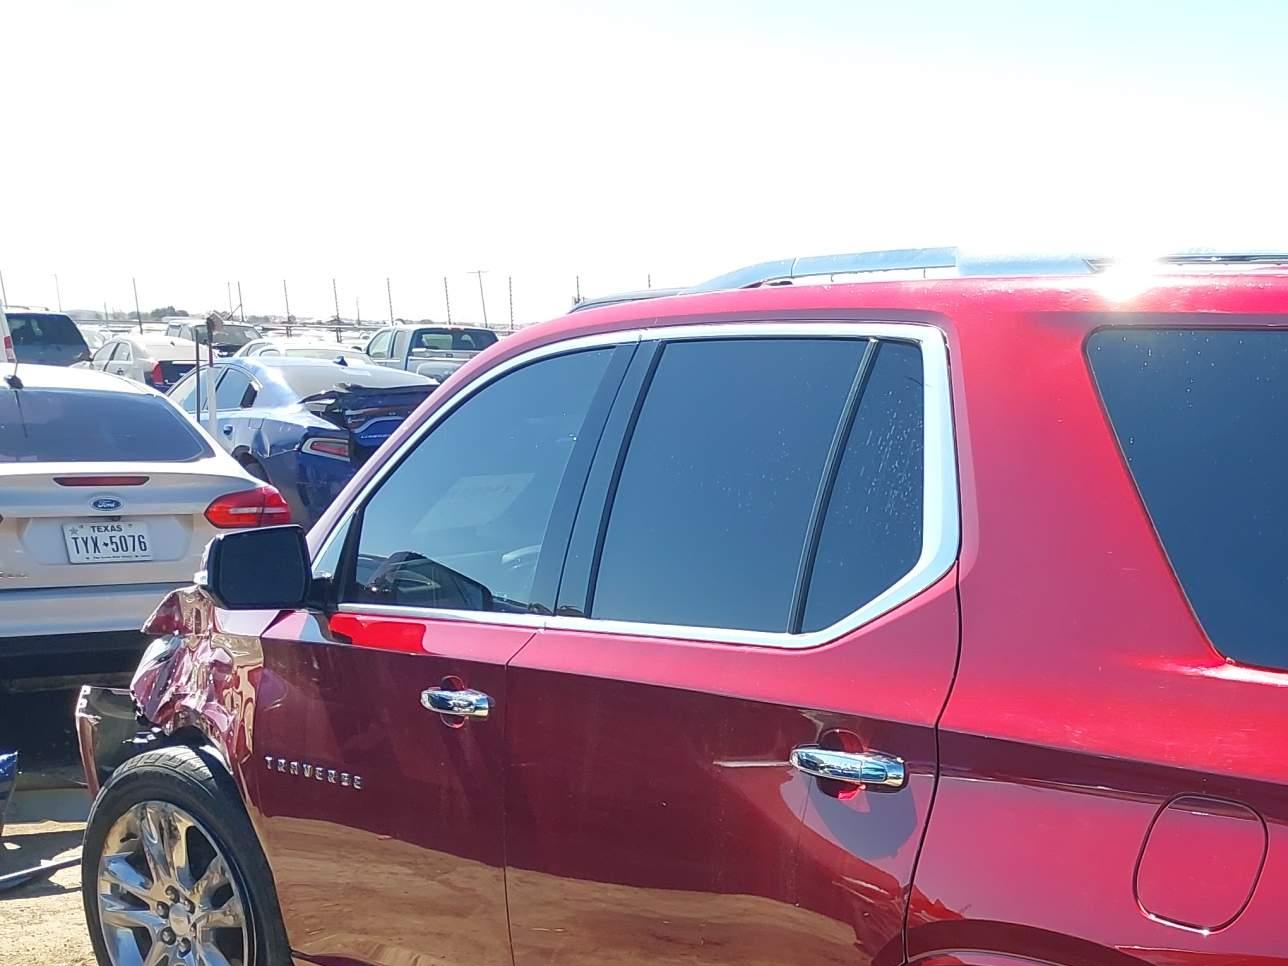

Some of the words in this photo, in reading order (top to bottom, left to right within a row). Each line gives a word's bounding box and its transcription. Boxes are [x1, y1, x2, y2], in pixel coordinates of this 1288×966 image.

[97, 499, 117, 509] Ford
[91, 524, 123, 533] TEXAS
[264, 755, 364, 790] TRAVERSE
